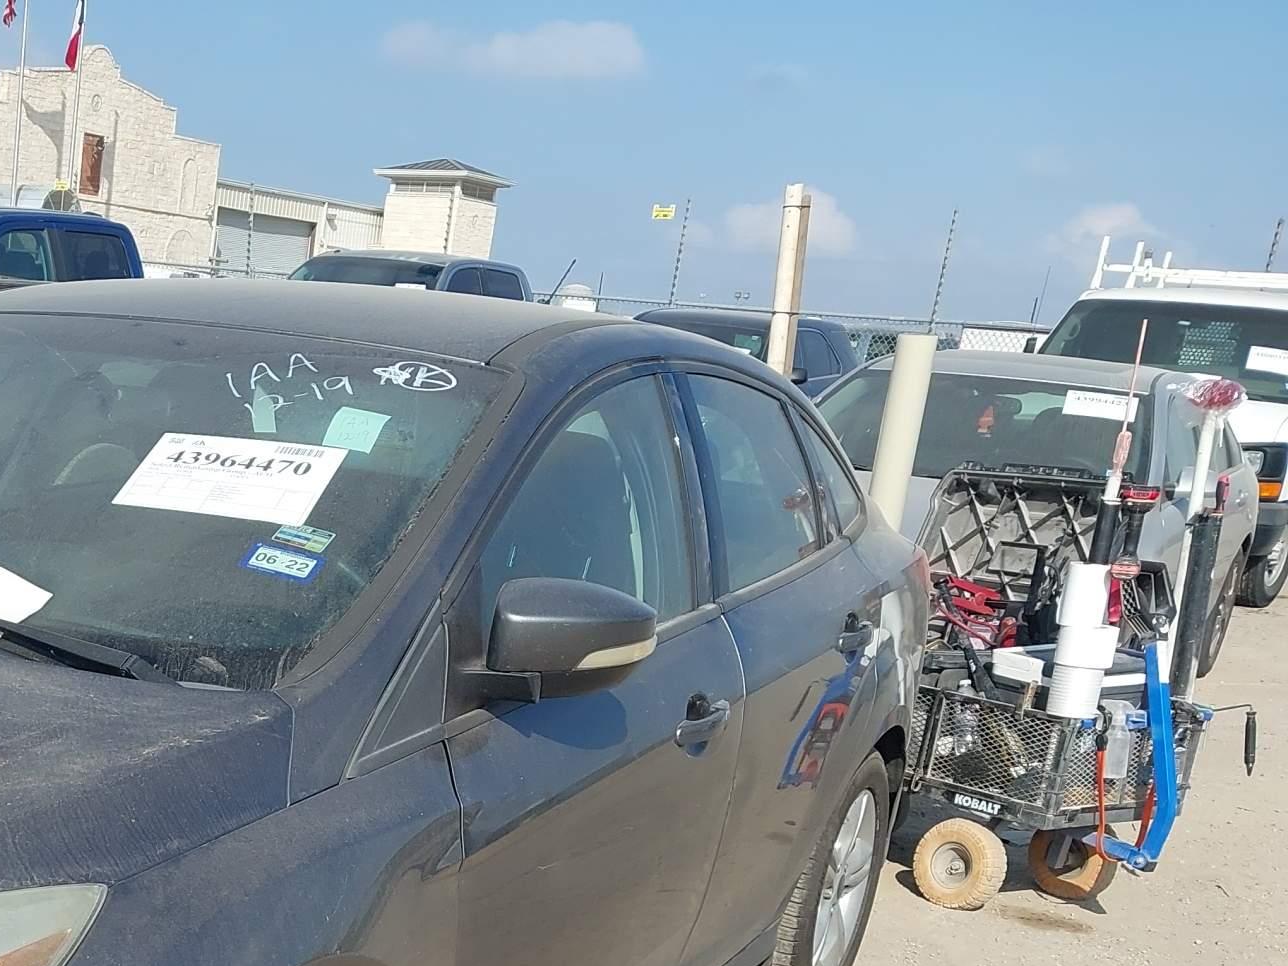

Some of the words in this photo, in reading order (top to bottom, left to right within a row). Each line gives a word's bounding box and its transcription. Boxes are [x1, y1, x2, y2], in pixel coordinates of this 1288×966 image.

[225, 353, 319, 398] IAA
[166, 450, 312, 476] 43964470
[954, 793, 1001, 815] KOBALT
